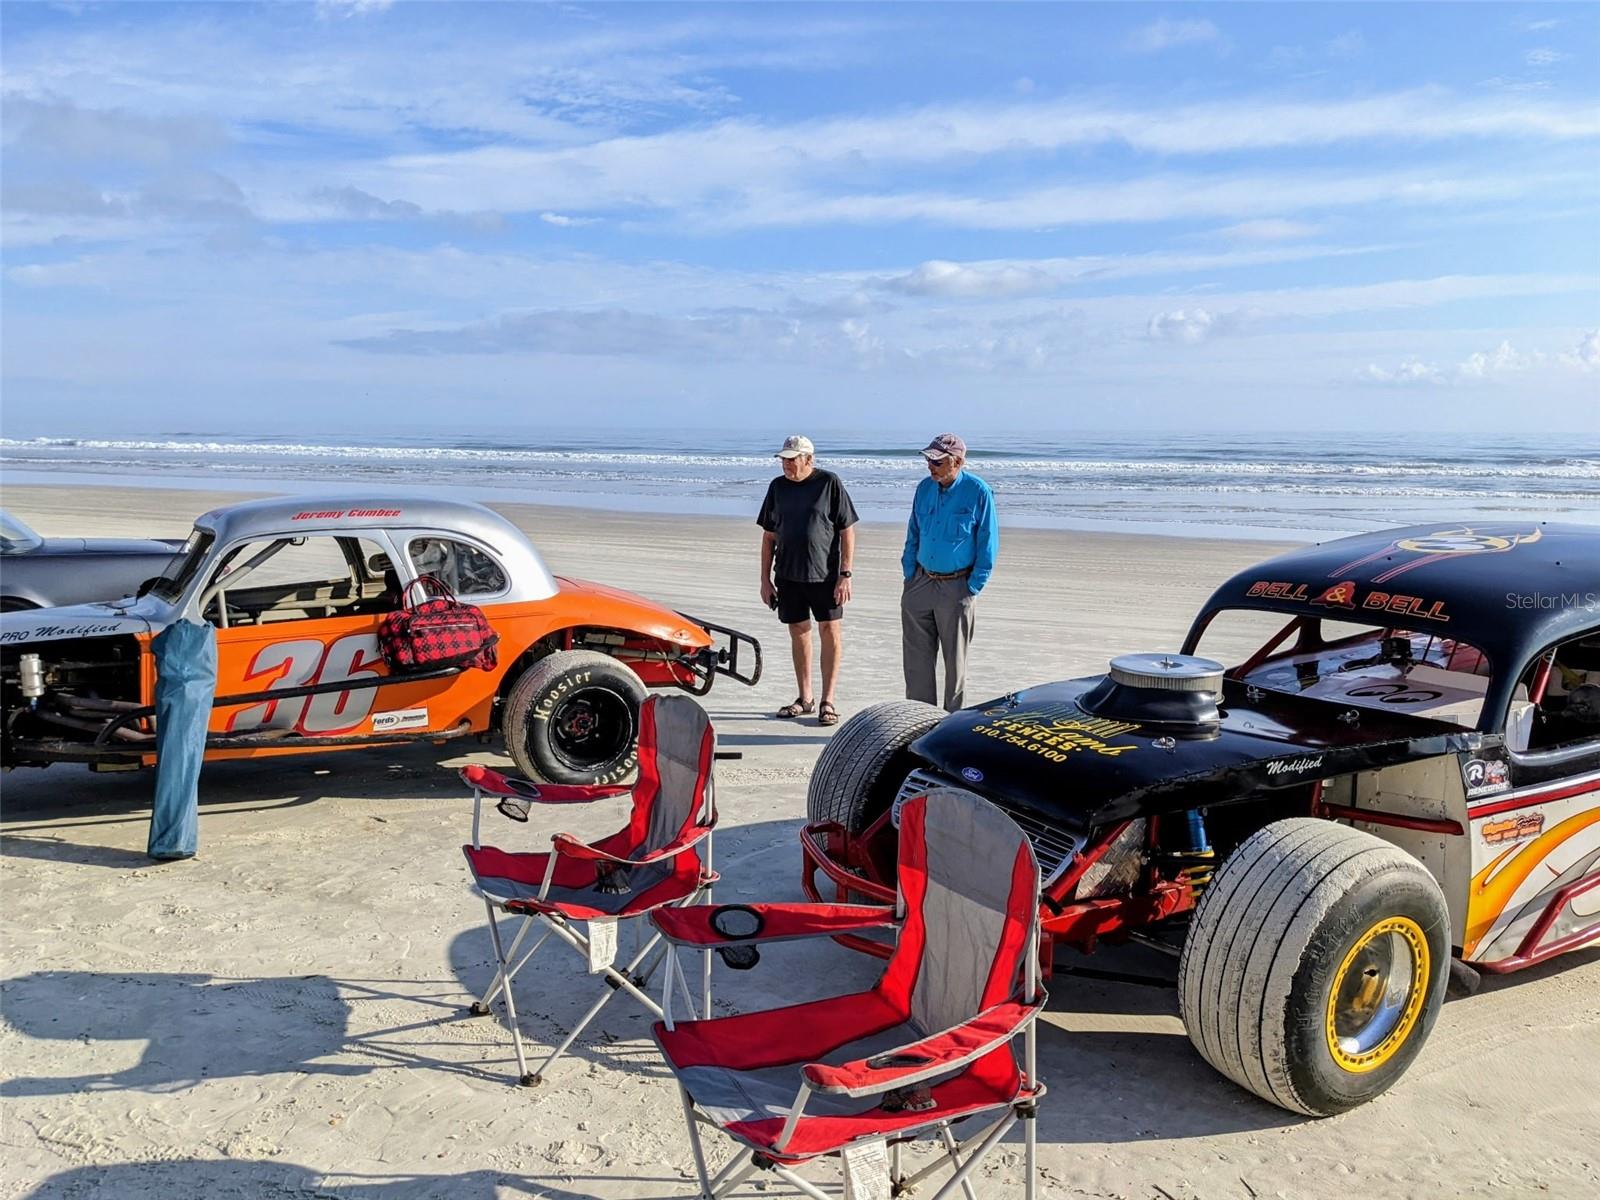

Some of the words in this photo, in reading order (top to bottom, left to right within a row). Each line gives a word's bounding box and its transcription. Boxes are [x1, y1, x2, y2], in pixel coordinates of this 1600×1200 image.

[291, 510, 345, 521] Jeremy
[1246, 581, 1309, 601] BELL
[1363, 591, 1450, 622] BELL
[0, 630, 30, 641] PRO
[35, 622, 122, 638] Modified
[533, 671, 592, 721] Hoosier
[972, 725, 1068, 763] 910.754.6100
[1266, 755, 1323, 775] Modified
[1467, 764, 1484, 781] R
